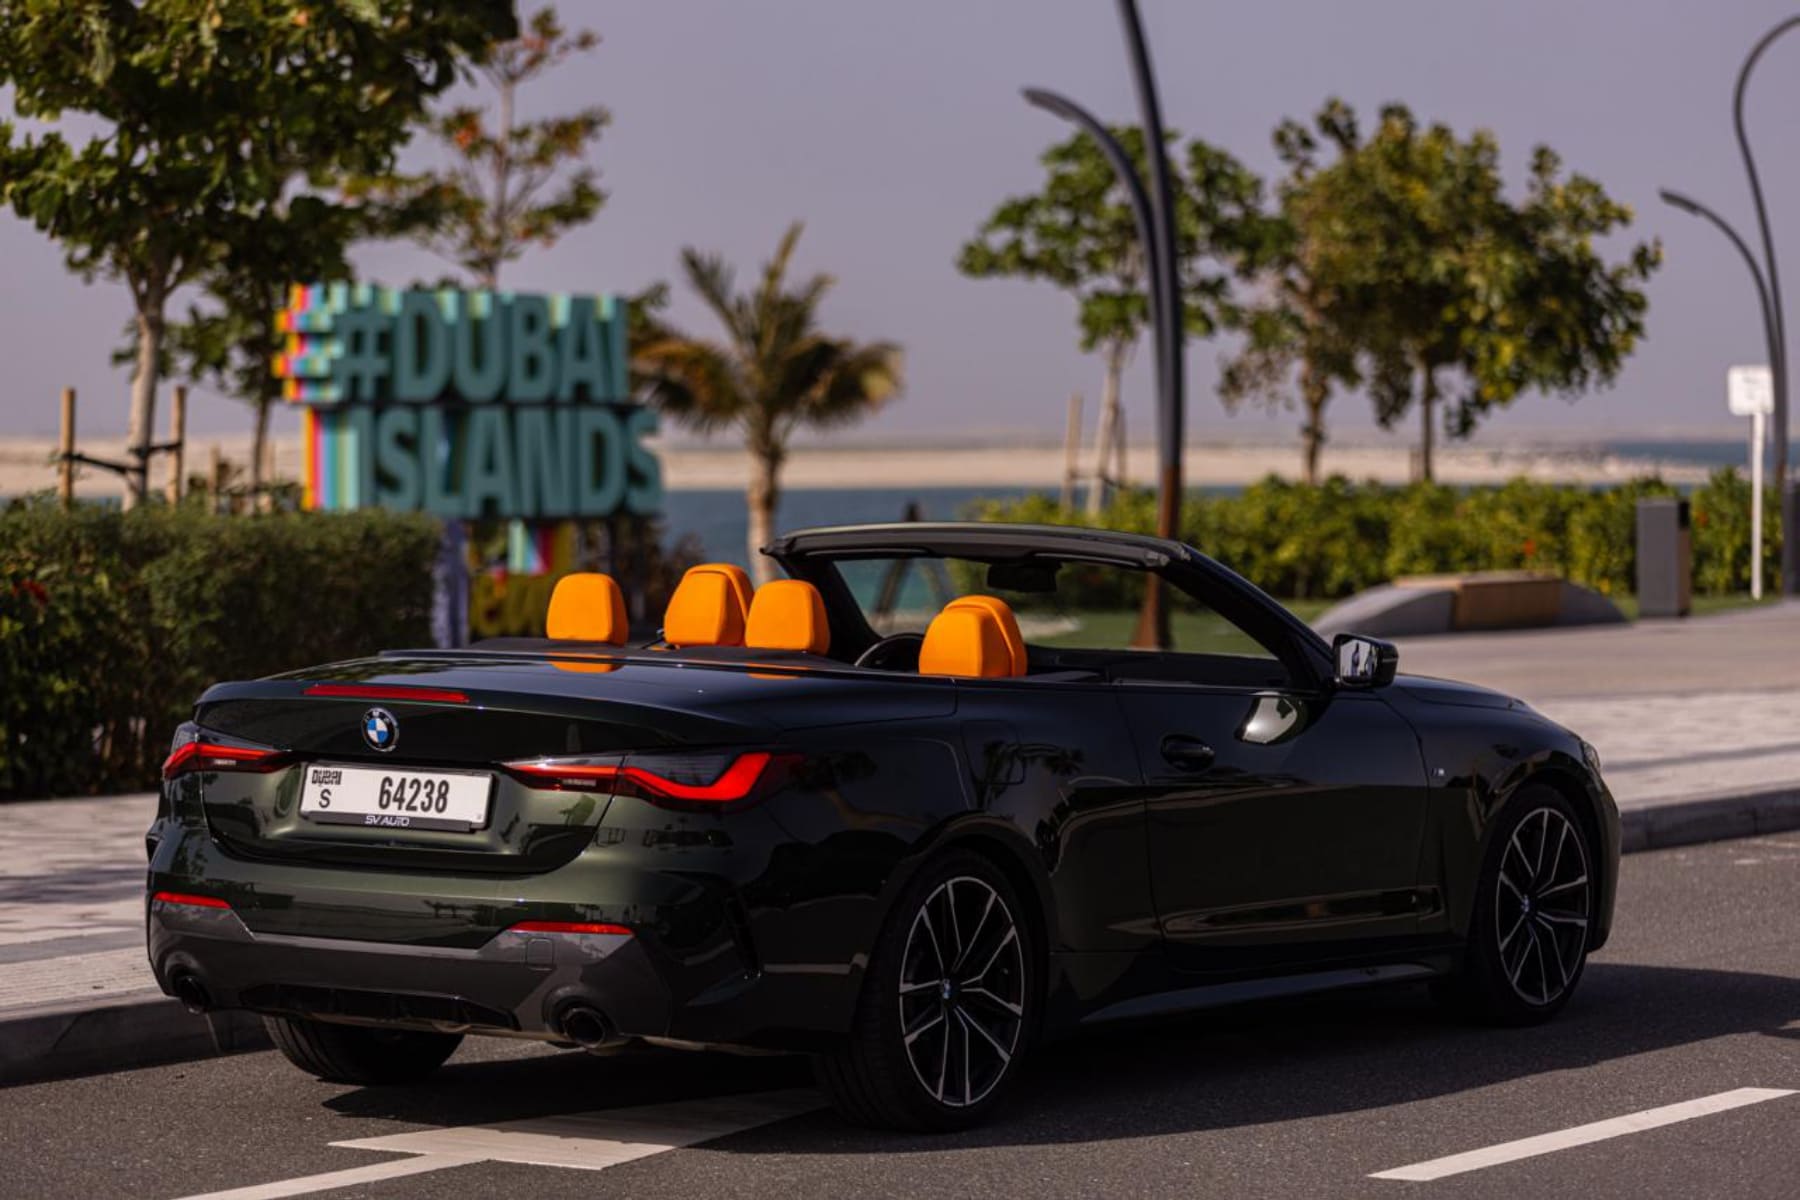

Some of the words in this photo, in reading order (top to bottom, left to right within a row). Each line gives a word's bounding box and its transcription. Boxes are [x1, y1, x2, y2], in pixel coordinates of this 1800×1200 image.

[330, 292, 630, 402] #DUBAI
[357, 404, 663, 518] ISLANDS
[318, 788, 332, 809] S
[378, 776, 450, 814] 64238
[364, 815, 382, 825] SV
[380, 816, 410, 827] AUTO
